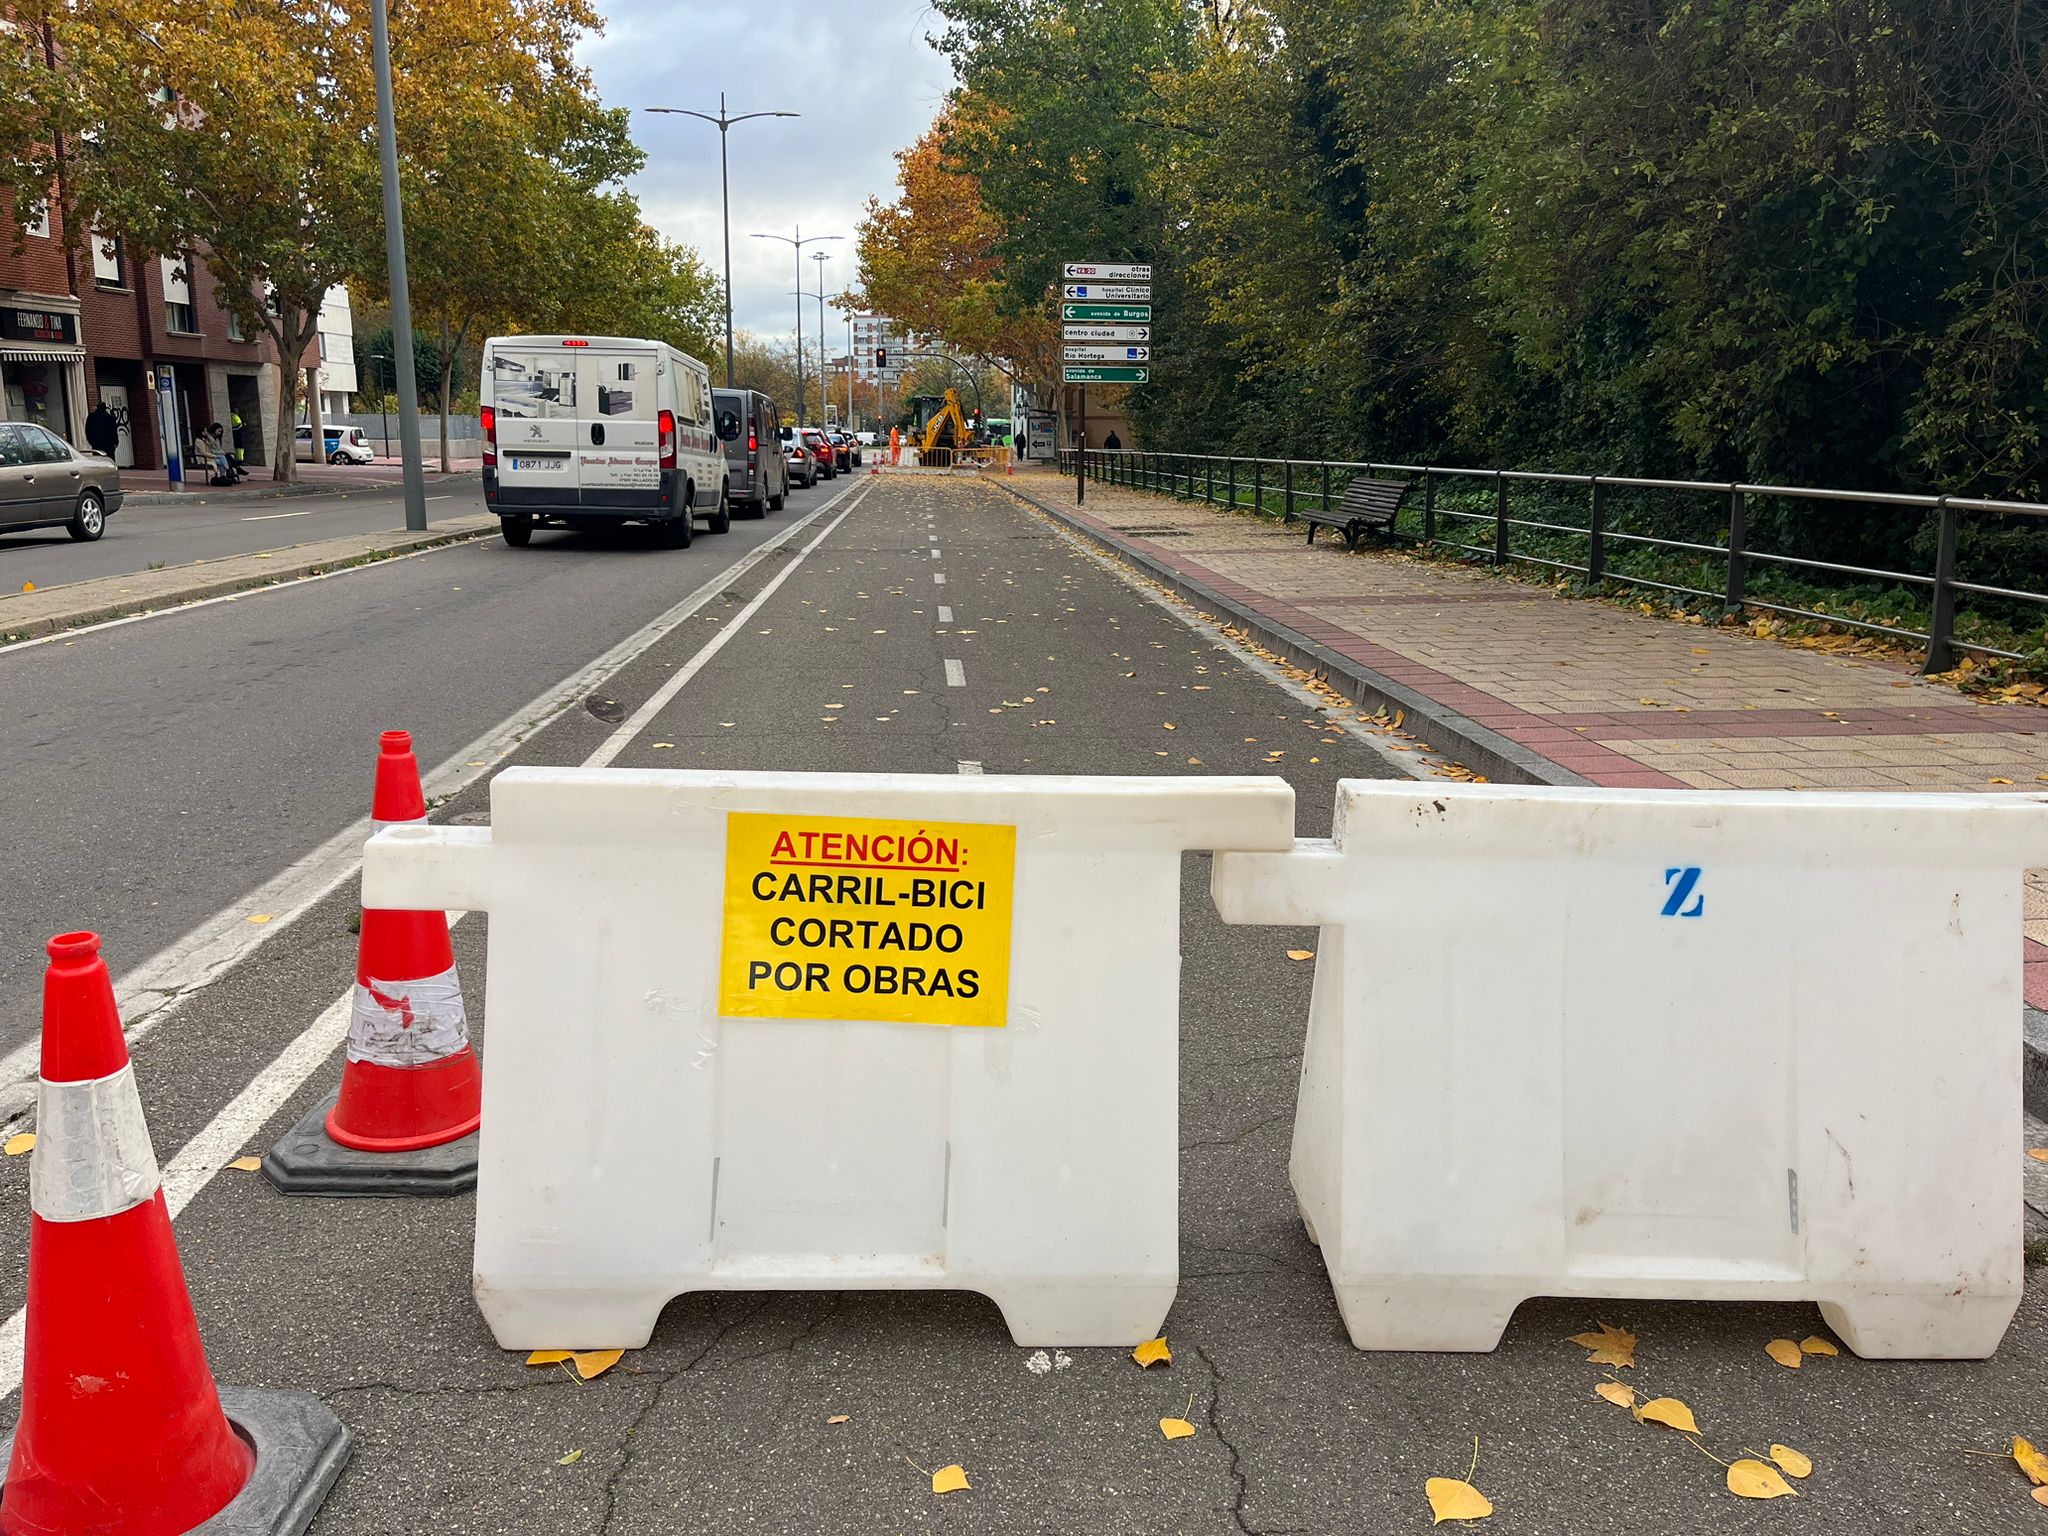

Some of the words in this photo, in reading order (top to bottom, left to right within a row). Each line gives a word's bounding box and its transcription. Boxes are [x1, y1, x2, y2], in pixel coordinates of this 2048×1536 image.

[17, 312, 44, 329] FERNANDO
[1123, 310, 1149, 319] Burgos
[1090, 329, 1115, 337] ciudad
[1078, 352, 1105, 360] Hortega
[519, 460, 542, 469] 0871
[545, 460, 562, 469] JJG
[770, 829, 969, 868] ATENCIÓN:
[751, 871, 985, 910] CARRIL-BICI
[1660, 867, 1704, 917] Z
[770, 916, 963, 953] CORTADO
[748, 961, 830, 992] POR
[843, 964, 980, 999] OBRAS
